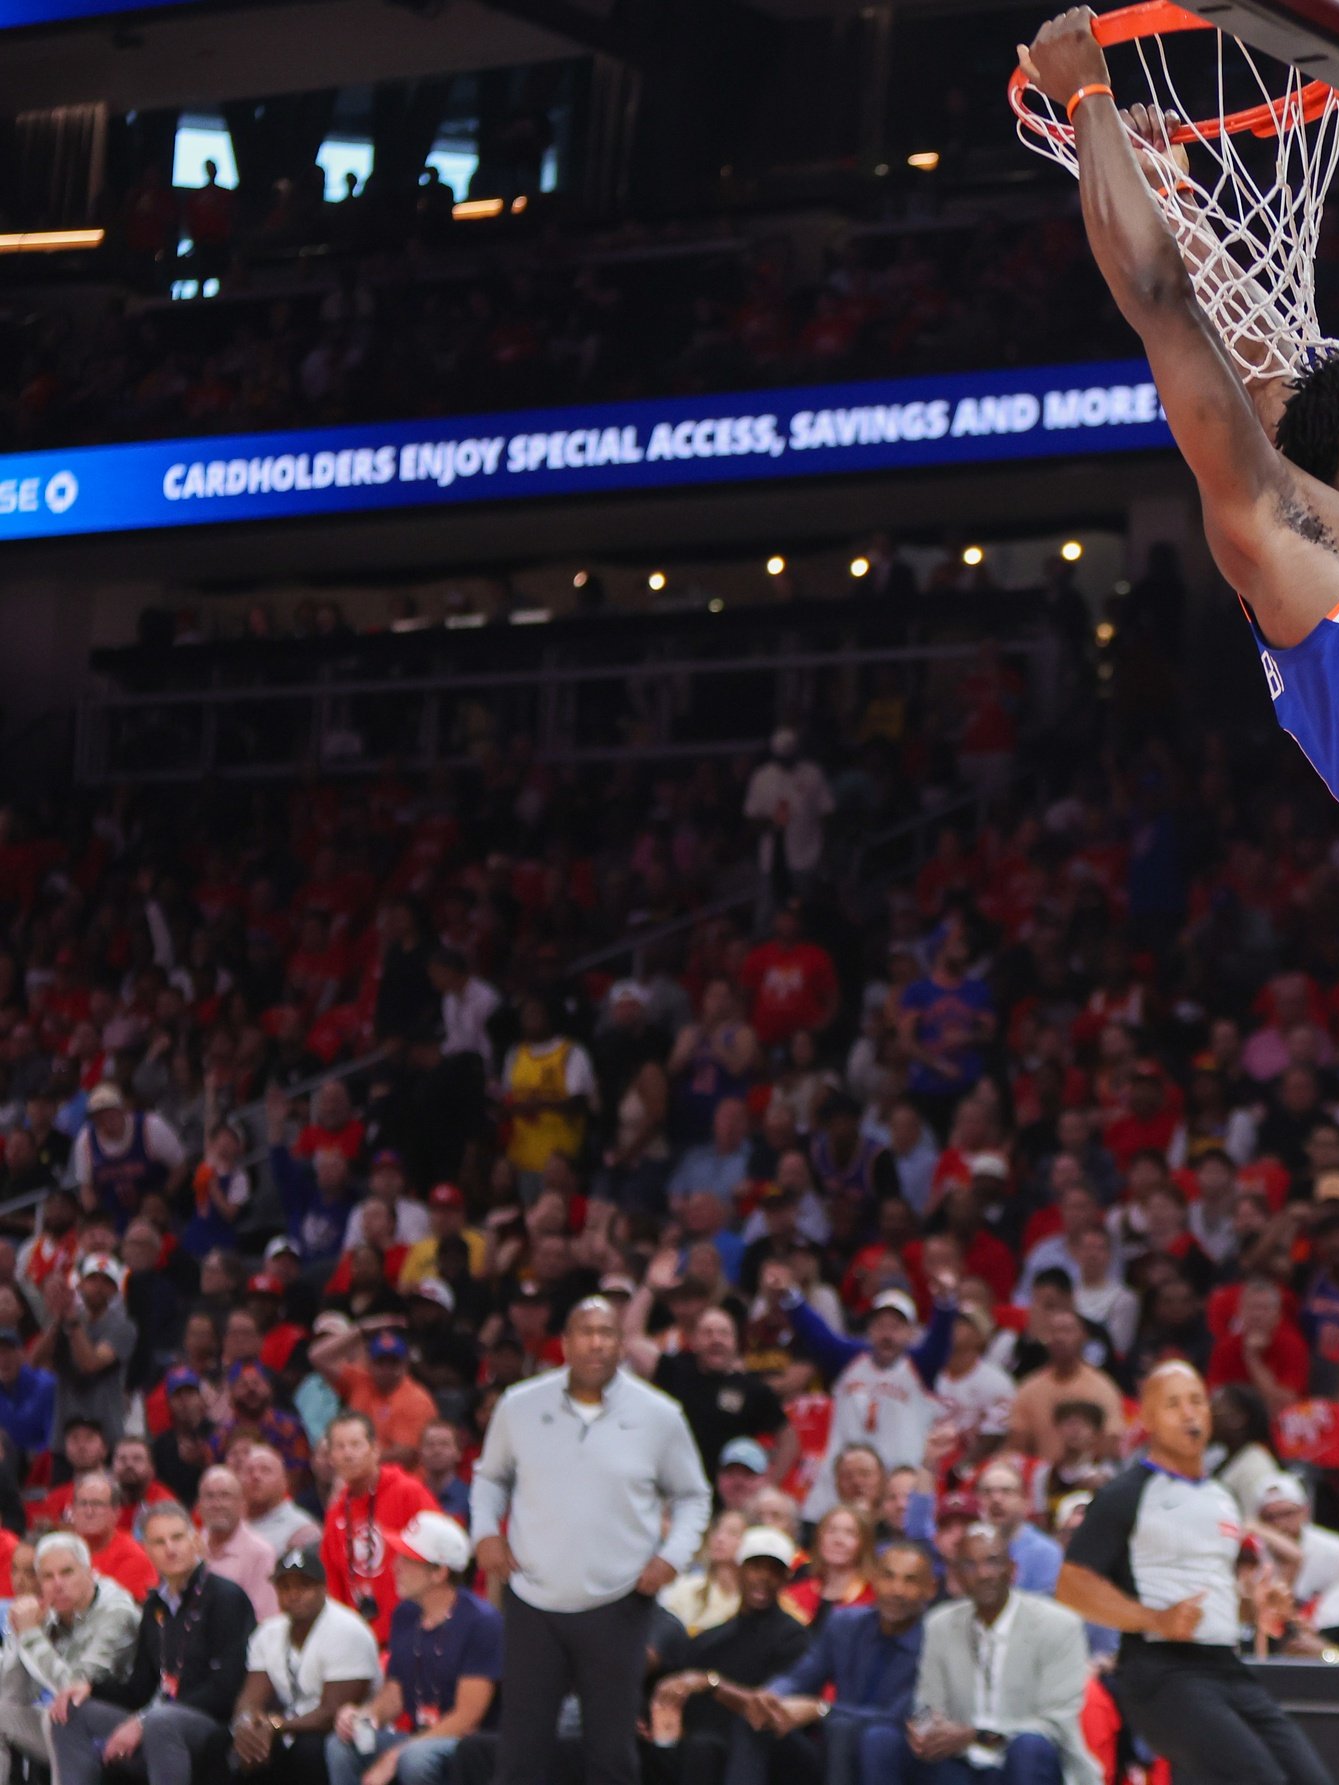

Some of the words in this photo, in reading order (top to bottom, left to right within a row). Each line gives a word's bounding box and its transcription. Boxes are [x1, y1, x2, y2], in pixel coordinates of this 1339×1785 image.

[163, 446, 396, 500] CARDHOLDERS
[399, 438, 505, 488] ENJOY
[506, 425, 644, 473] SPECIAL
[645, 414, 786, 458] ACCESS,
[789, 399, 951, 450] SAVINGS
[951, 393, 1041, 437] AND
[1043, 383, 1160, 430] MORE
